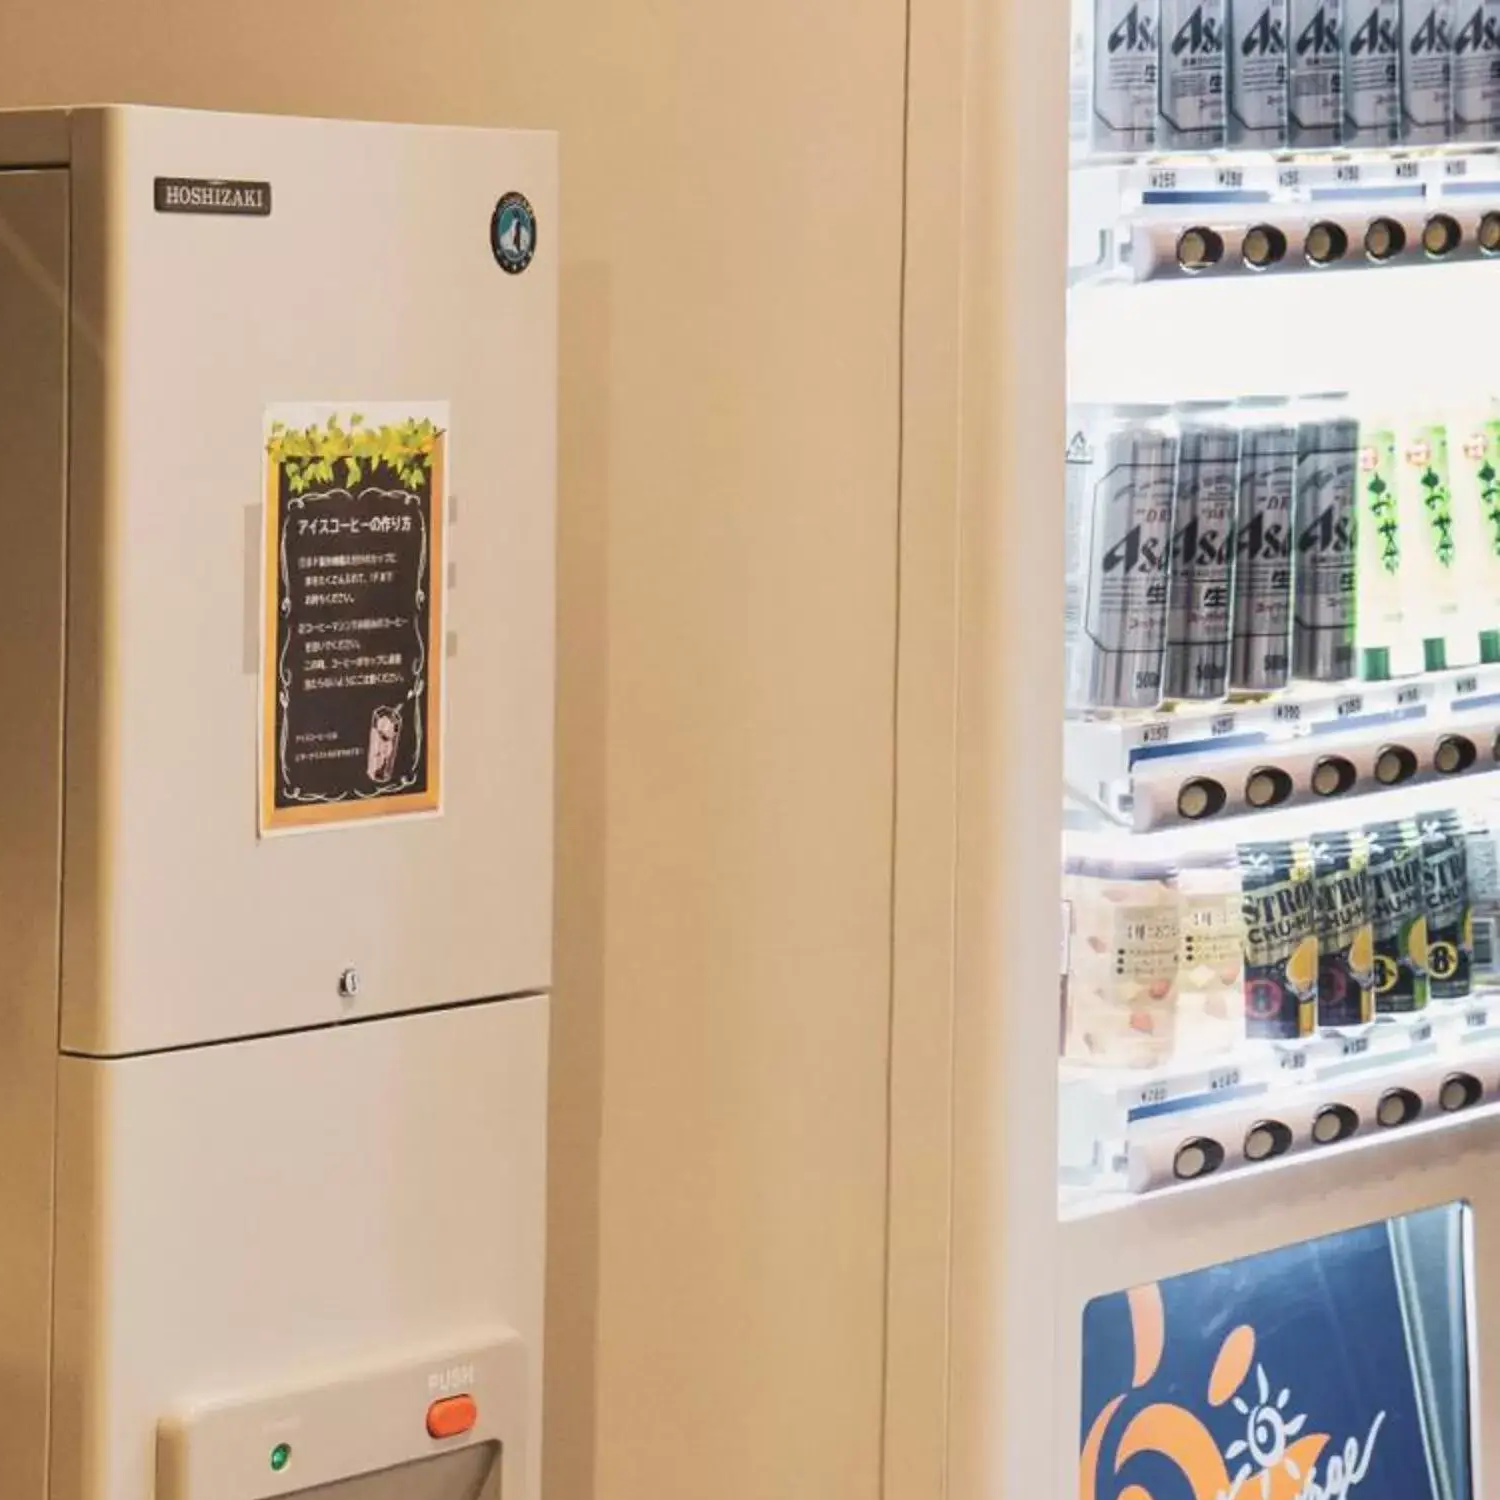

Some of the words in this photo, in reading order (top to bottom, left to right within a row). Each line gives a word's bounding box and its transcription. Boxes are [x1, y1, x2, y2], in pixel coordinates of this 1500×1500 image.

[1108, 3, 1155, 53] As
[1171, 4, 1222, 57] As
[1242, 6, 1285, 56] As
[1297, 6, 1341, 55] As
[1350, 7, 1397, 55] As
[1410, 8, 1450, 54] As
[1453, 6, 1500, 55] As
[166, 185, 262, 207] HOSHIZAKI
[297, 515, 411, 536] アイスコーヒーの作り方
[428, 1363, 473, 1391] PUSH
